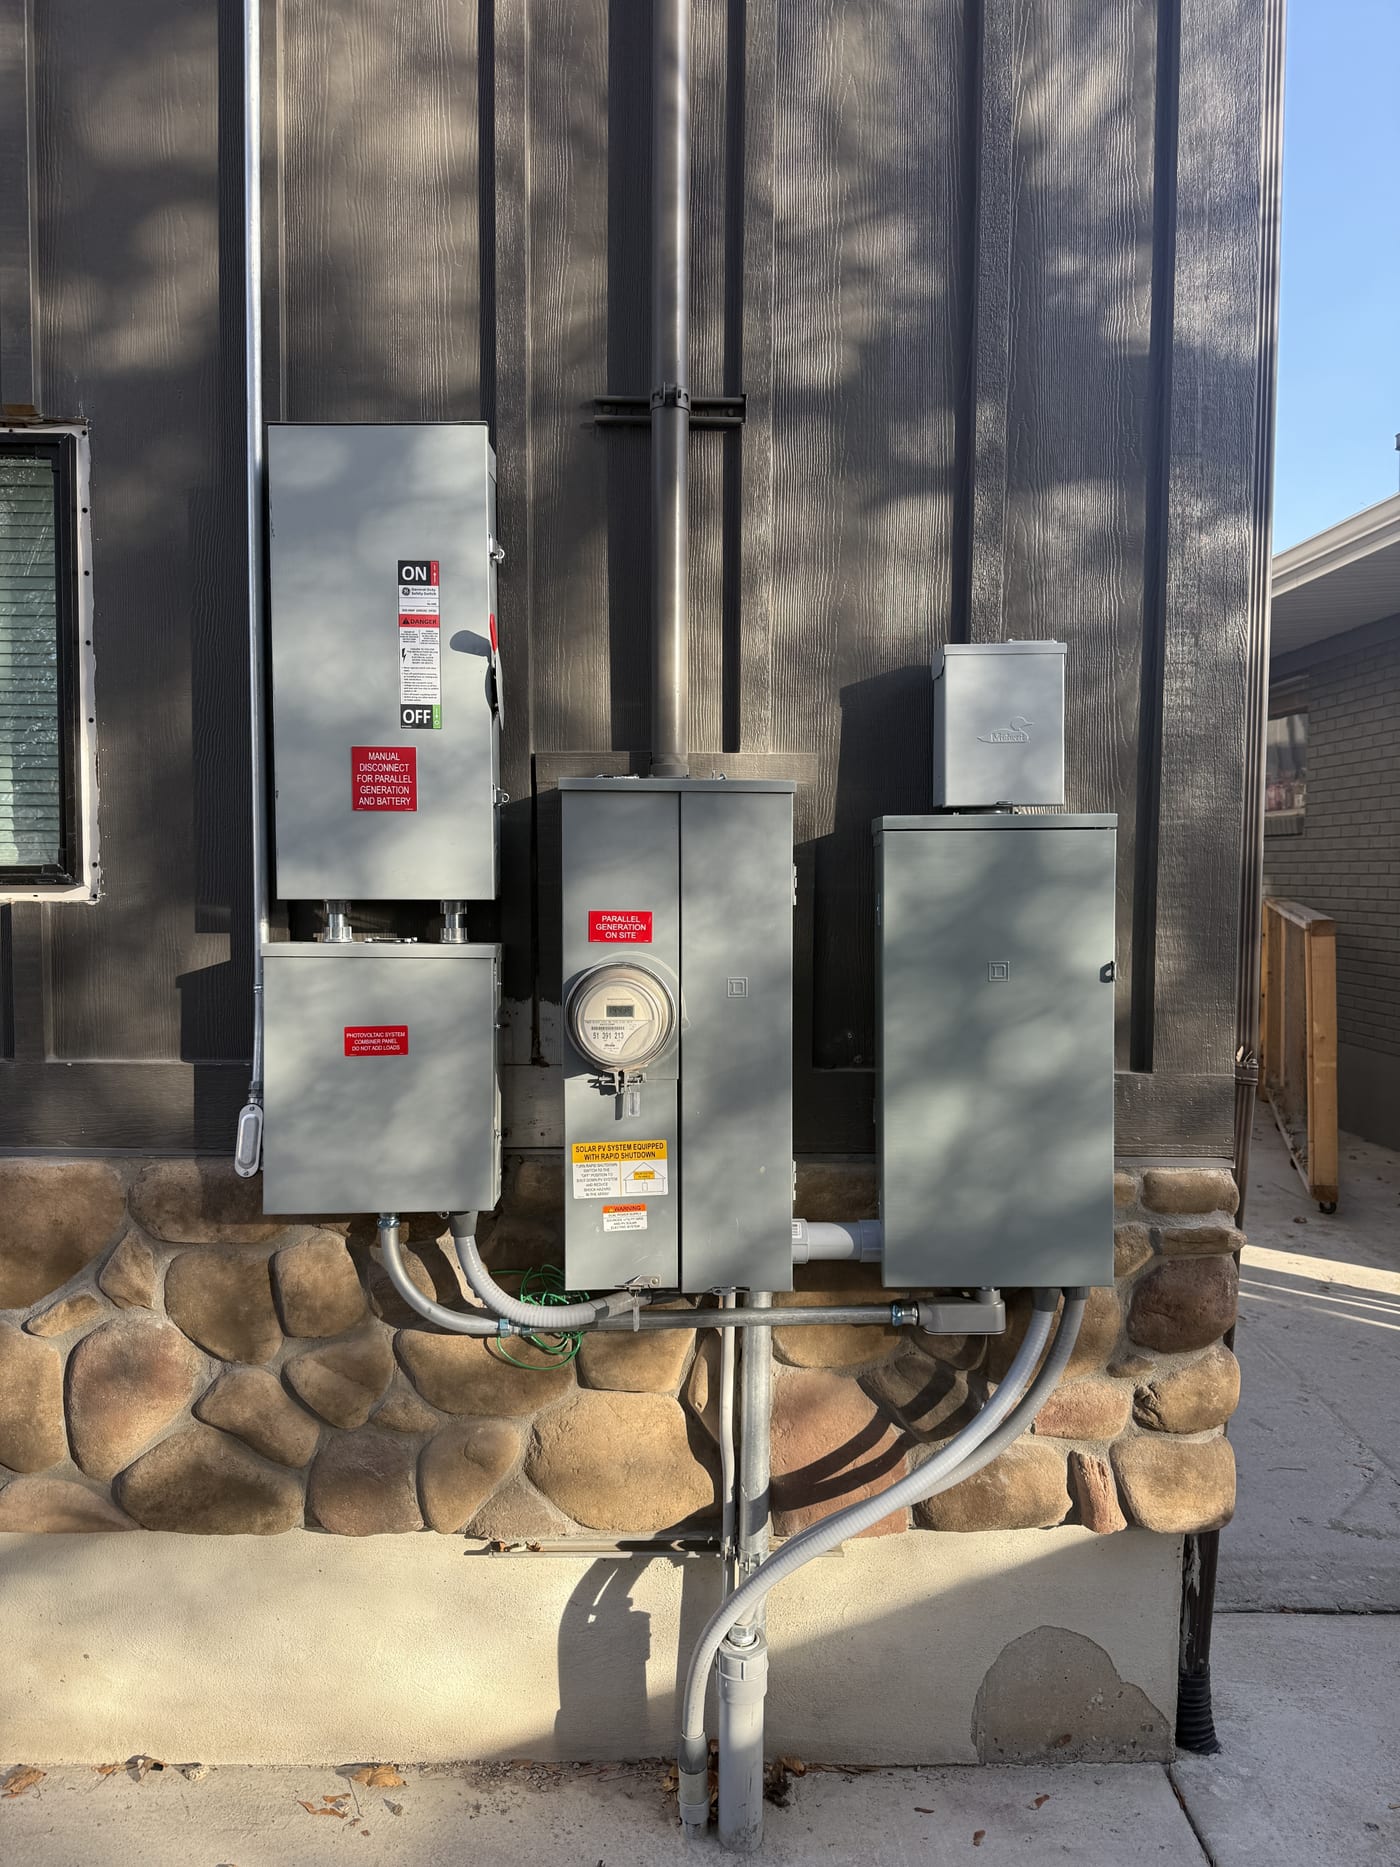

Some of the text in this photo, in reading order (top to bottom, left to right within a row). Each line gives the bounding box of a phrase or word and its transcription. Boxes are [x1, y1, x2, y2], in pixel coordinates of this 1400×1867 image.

[402, 566, 427, 581] ON
[403, 709, 431, 724] OFF
[368, 752, 400, 760] MANUAL
[360, 763, 409, 772] DISCONNECT
[357, 774, 412, 783] FOR PARALLEL
[360, 786, 409, 794] GENERATION
[359, 797, 411, 805] AND BATTERY
[575, 1145, 597, 1153] SOLAR
[633, 1142, 664, 1151] EQUIPPED
[601, 1152, 619, 1160] RAPID
[620, 1151, 656, 1159] SHUTDOWN
